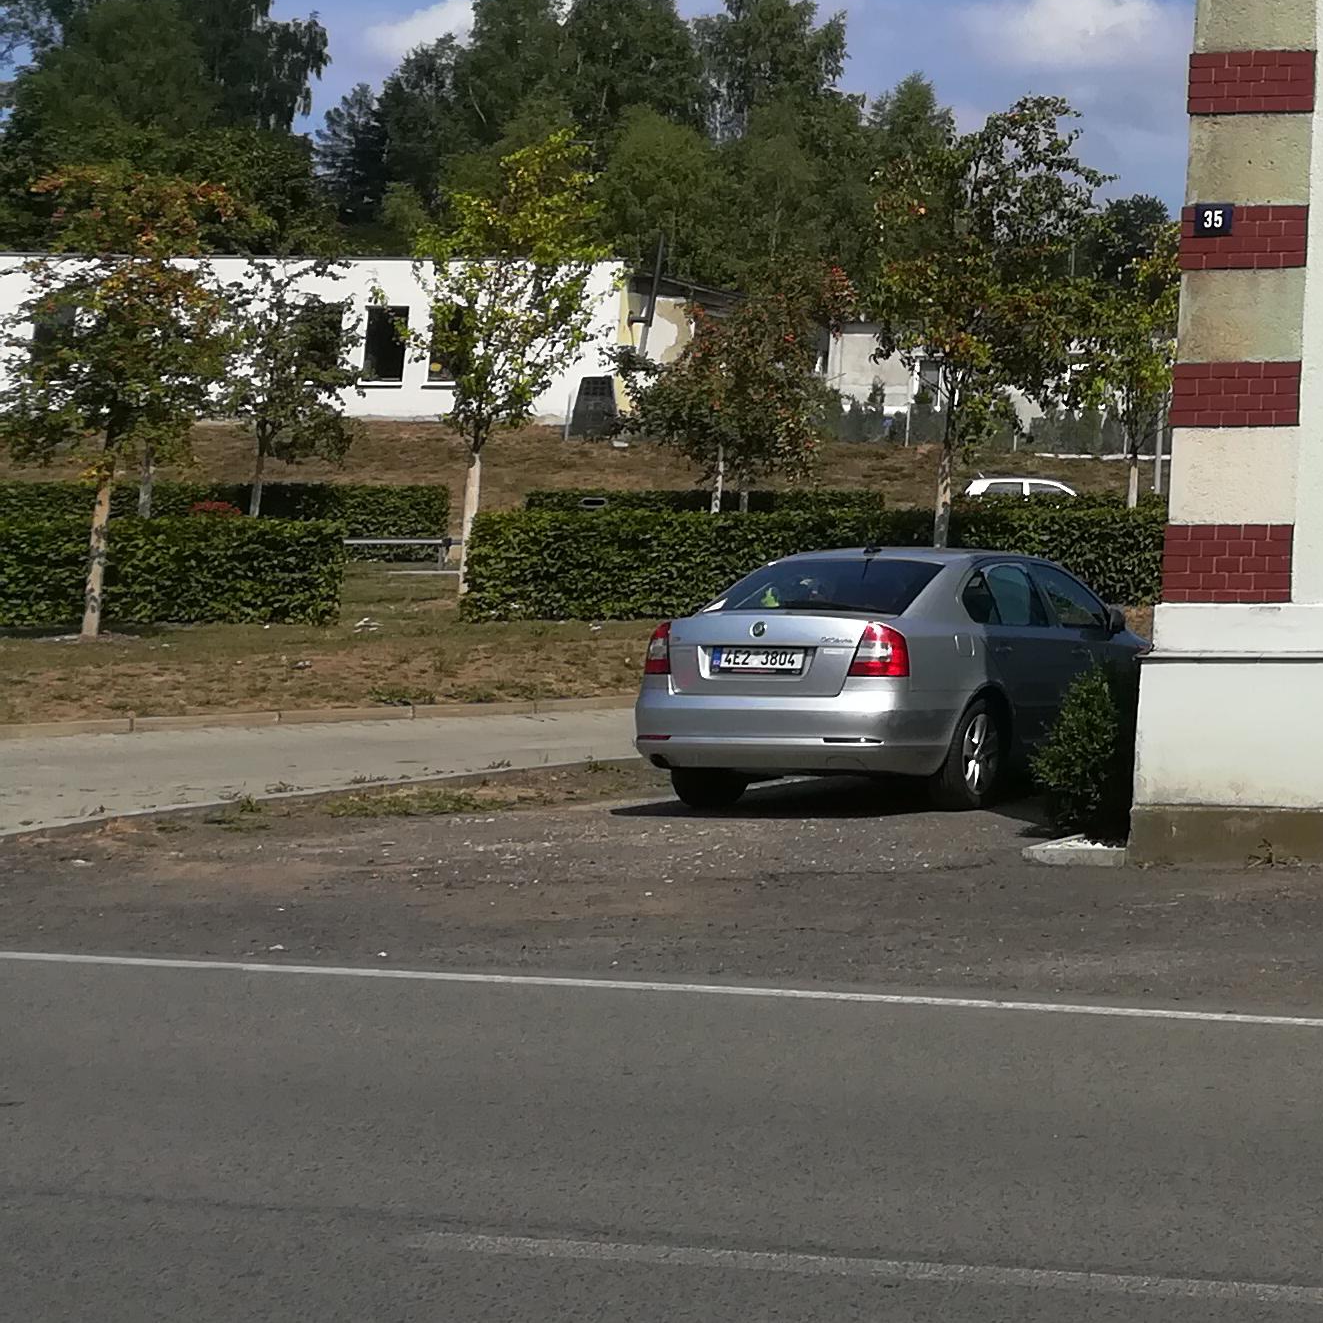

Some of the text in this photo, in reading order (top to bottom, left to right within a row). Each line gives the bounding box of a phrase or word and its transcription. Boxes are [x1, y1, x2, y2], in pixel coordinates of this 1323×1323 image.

[1203, 210, 1223, 228] 35
[724, 649, 796, 667] 4E2 3804
